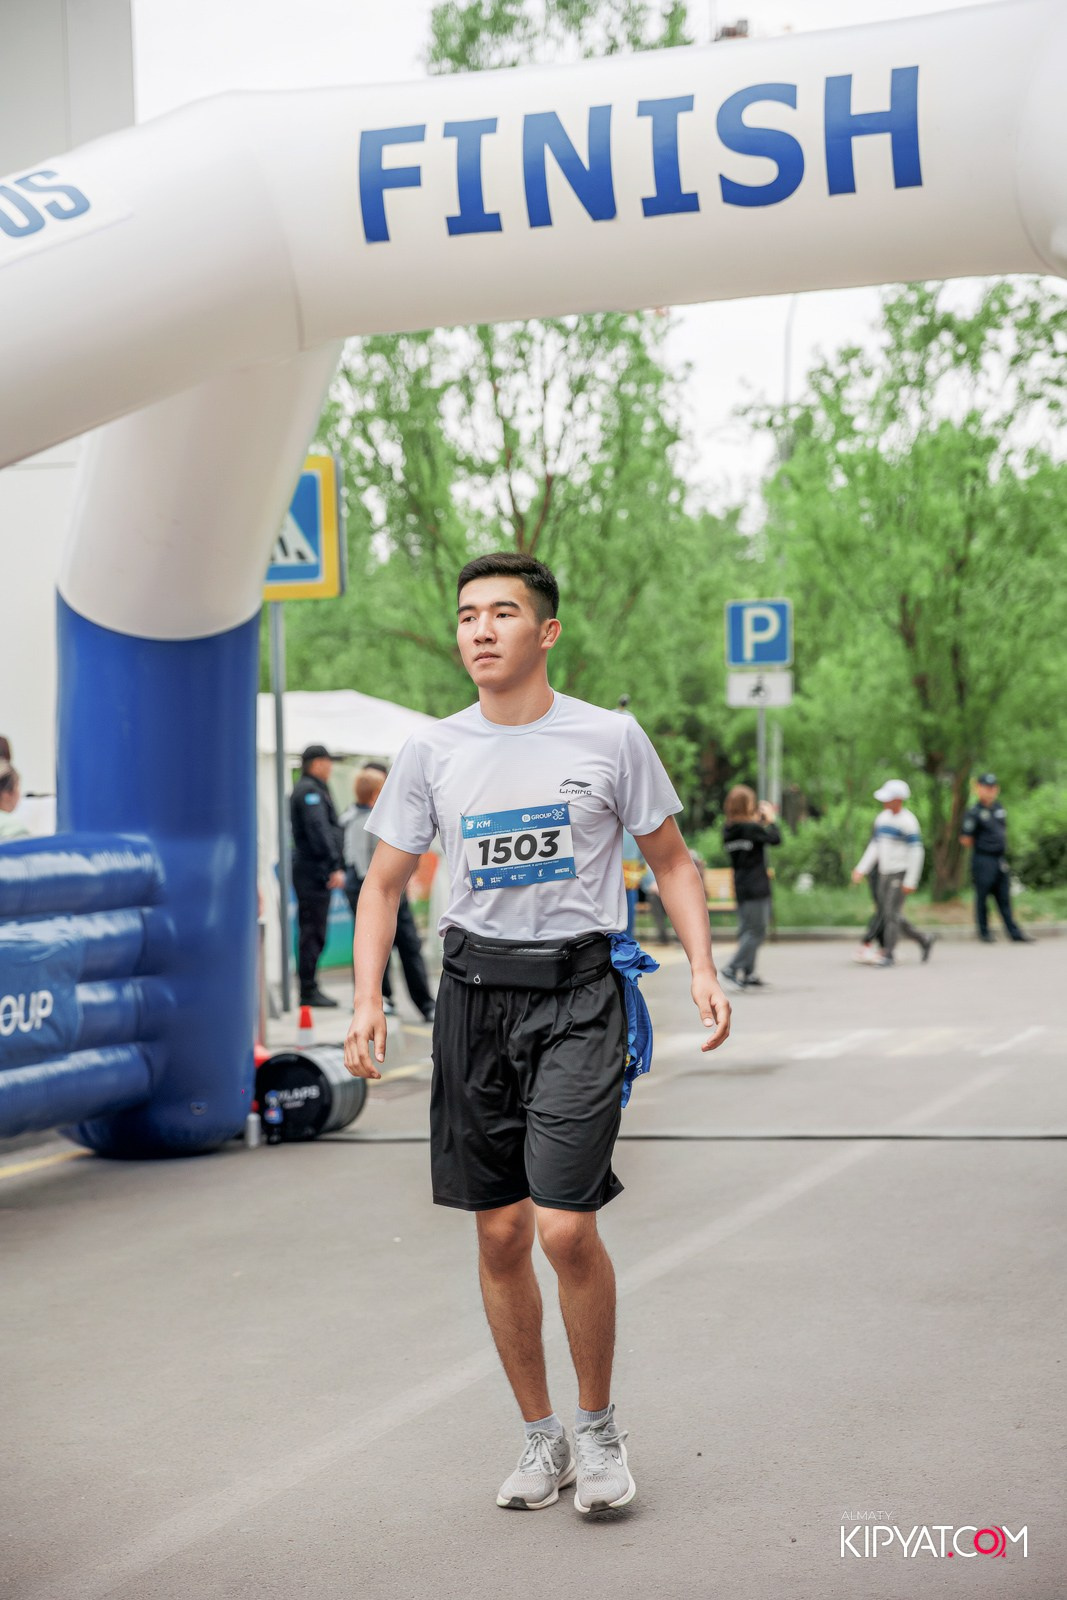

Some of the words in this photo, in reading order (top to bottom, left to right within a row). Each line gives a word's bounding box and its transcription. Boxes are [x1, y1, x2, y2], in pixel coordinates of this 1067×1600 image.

[358, 65, 923, 244] FINISH
[743, 607, 780, 660] P
[466, 819, 475, 830] 5
[476, 820, 491, 829] KM
[531, 812, 552, 821] GROUP
[478, 830, 561, 866] 1503
